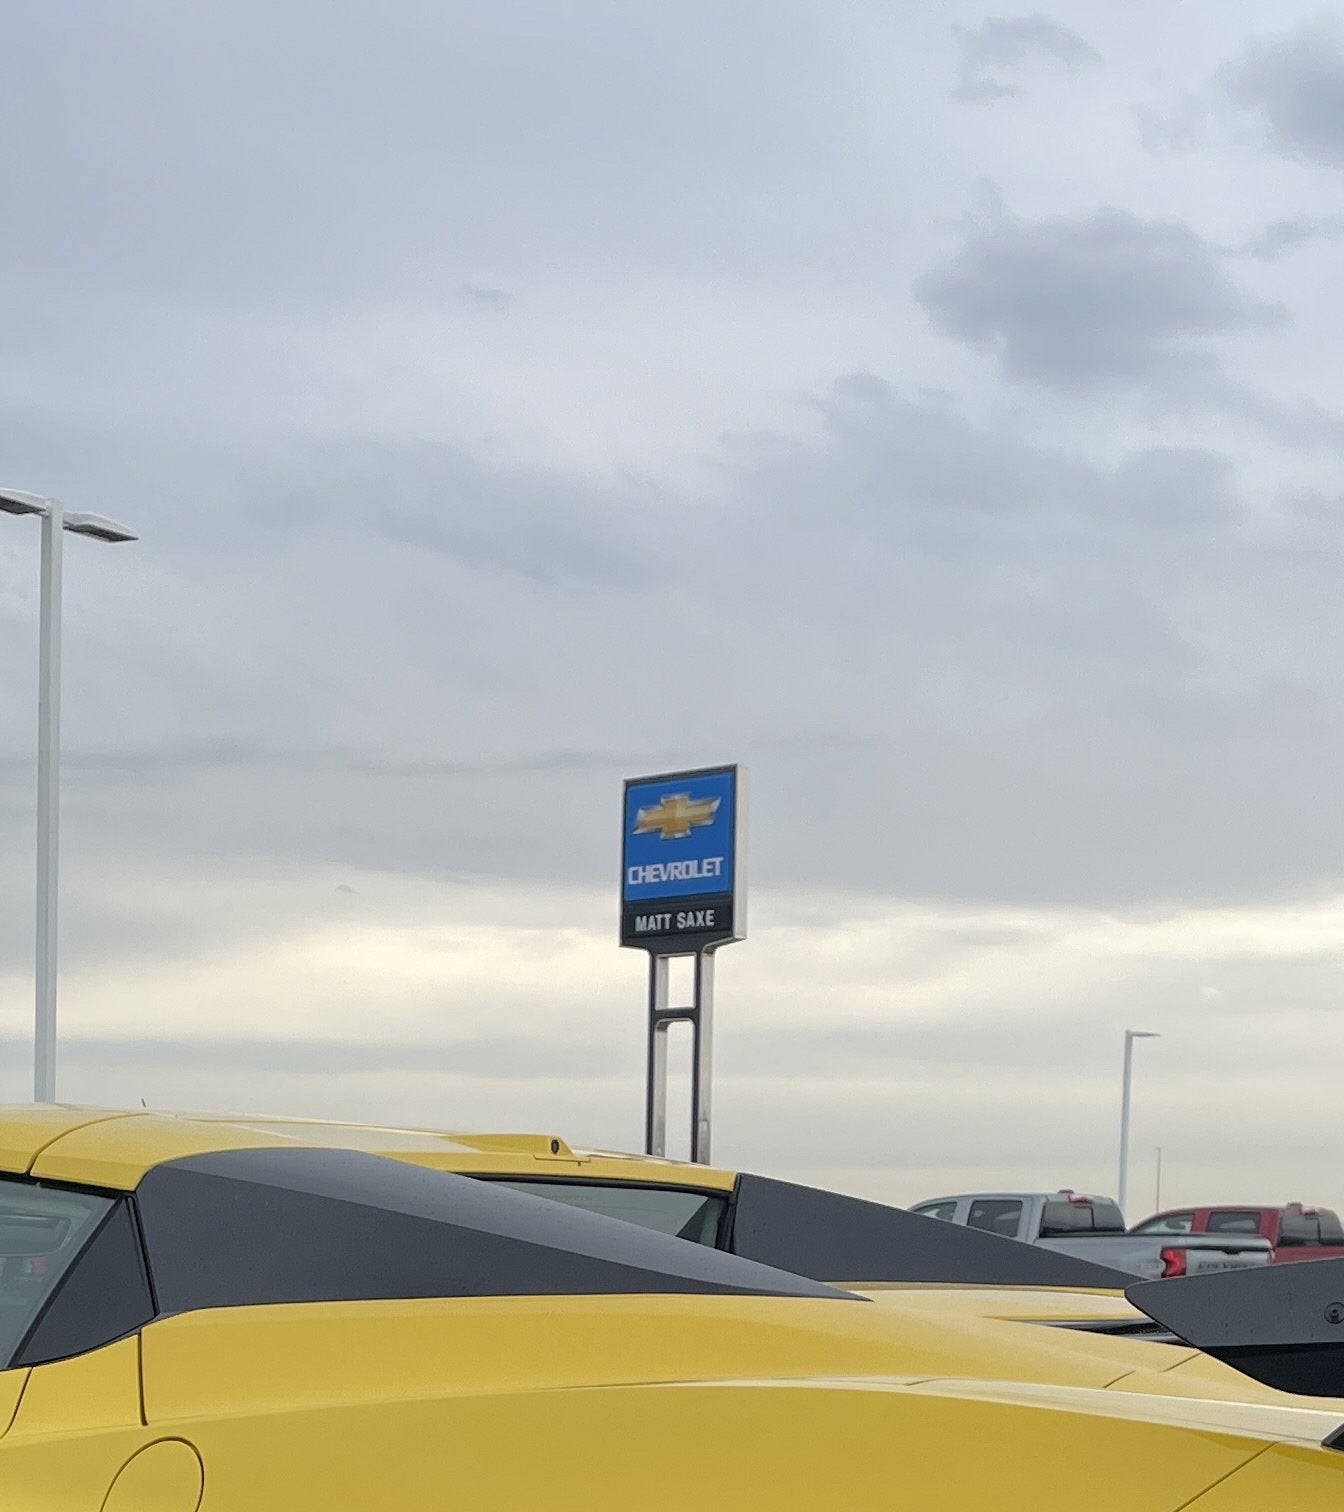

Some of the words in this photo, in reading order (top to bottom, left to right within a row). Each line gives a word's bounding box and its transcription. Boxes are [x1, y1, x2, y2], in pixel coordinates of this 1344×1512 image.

[628, 857, 724, 885] CHEVROLET
[635, 913, 672, 932] MATT
[676, 909, 715, 929] SAXE
